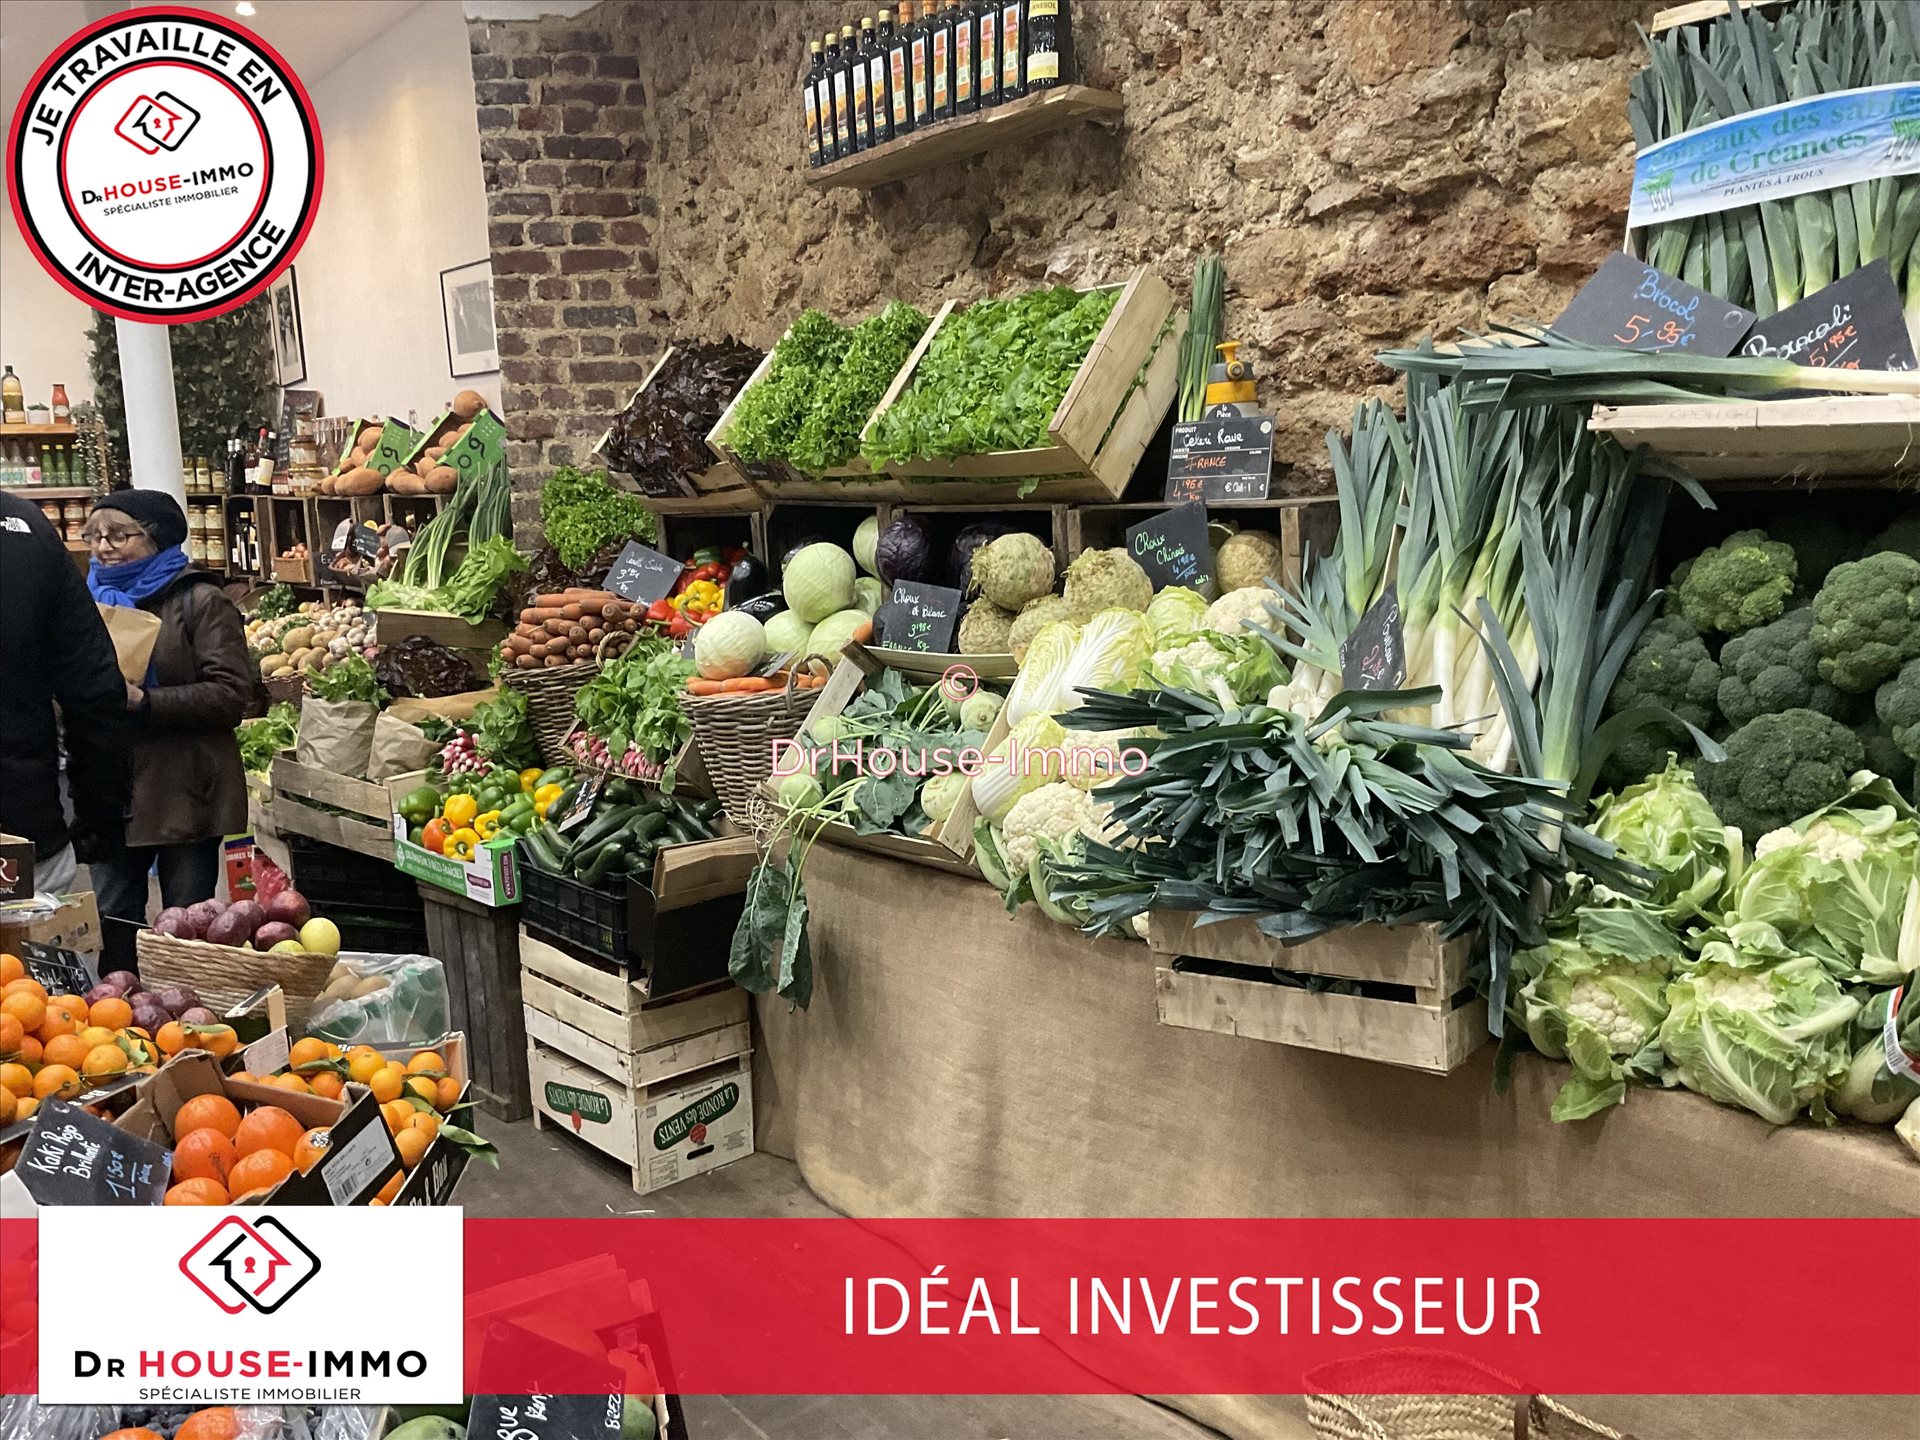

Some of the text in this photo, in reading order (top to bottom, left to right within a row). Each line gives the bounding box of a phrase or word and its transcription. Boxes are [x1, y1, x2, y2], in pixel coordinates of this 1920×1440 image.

[1772, 111, 1820, 136] des
[1690, 161, 1721, 185] de
[1729, 132, 1868, 174] Créances
[1785, 167, 1824, 184] TROUS
[1175, 426, 1197, 434] PRODUIT
[1217, 428, 1244, 444] Rave
[1184, 455, 1227, 471] FRANCE
[1156, 543, 1185, 565] Chinois
[922, 604, 947, 618] Blanc
[724, 1085, 735, 1102] La
[697, 1090, 726, 1120] RONDE
[685, 1107, 698, 1124] des
[41, 1124, 84, 1146] Rojo
[658, 1117, 687, 1144] VENTS
